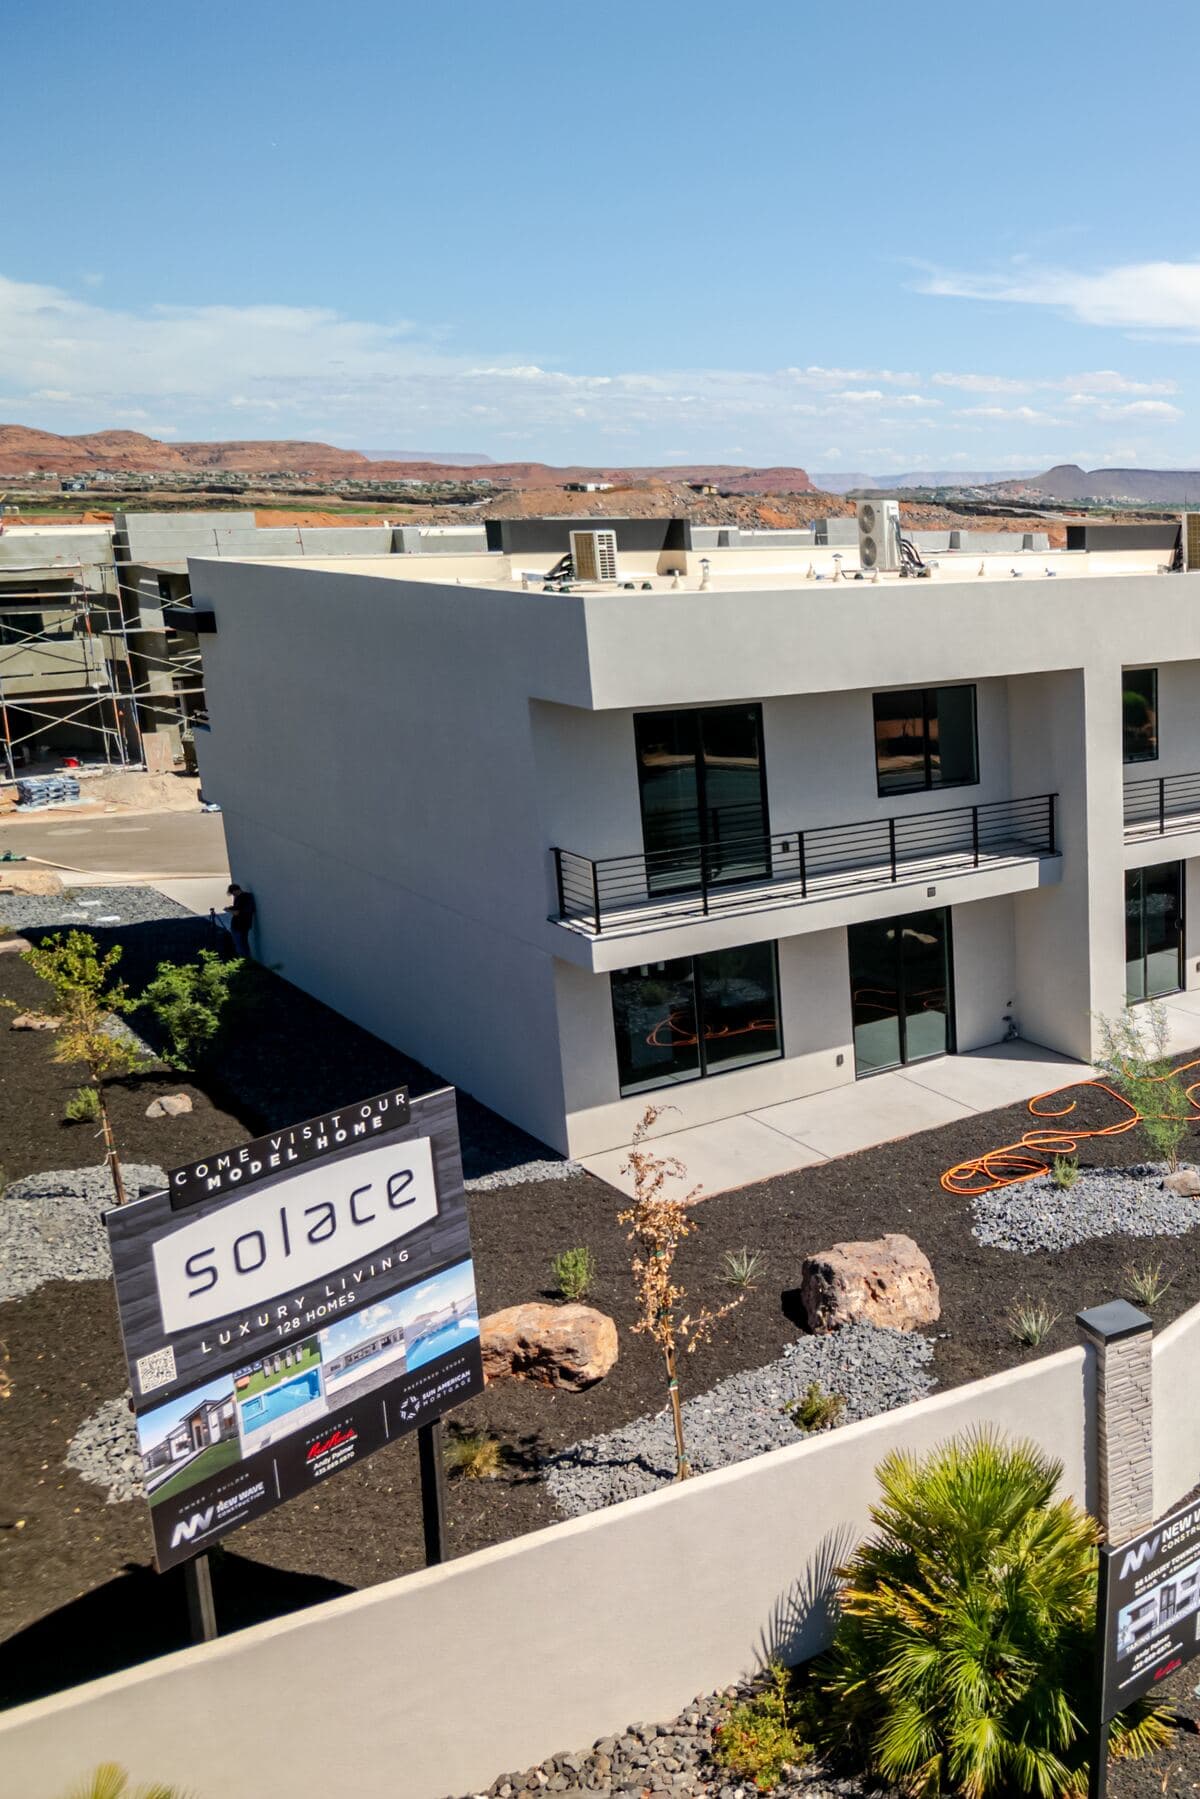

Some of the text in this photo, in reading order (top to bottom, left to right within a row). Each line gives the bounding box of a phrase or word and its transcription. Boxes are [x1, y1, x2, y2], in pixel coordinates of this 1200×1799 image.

[175, 1093, 405, 1186] COME VISIT OUR
[207, 1116, 382, 1191] MODEL HOME
[185, 1168, 417, 1299] solace
[201, 1250, 409, 1354] LUXURY LIVING
[277, 1291, 356, 1336] 128 HOMES
[422, 1369, 471, 1401] SUN AMERICAN
[423, 1377, 471, 1407] MORTGAGE
[216, 1481, 264, 1513] NEW WAVE
[1162, 1514, 1193, 1542] NEW
